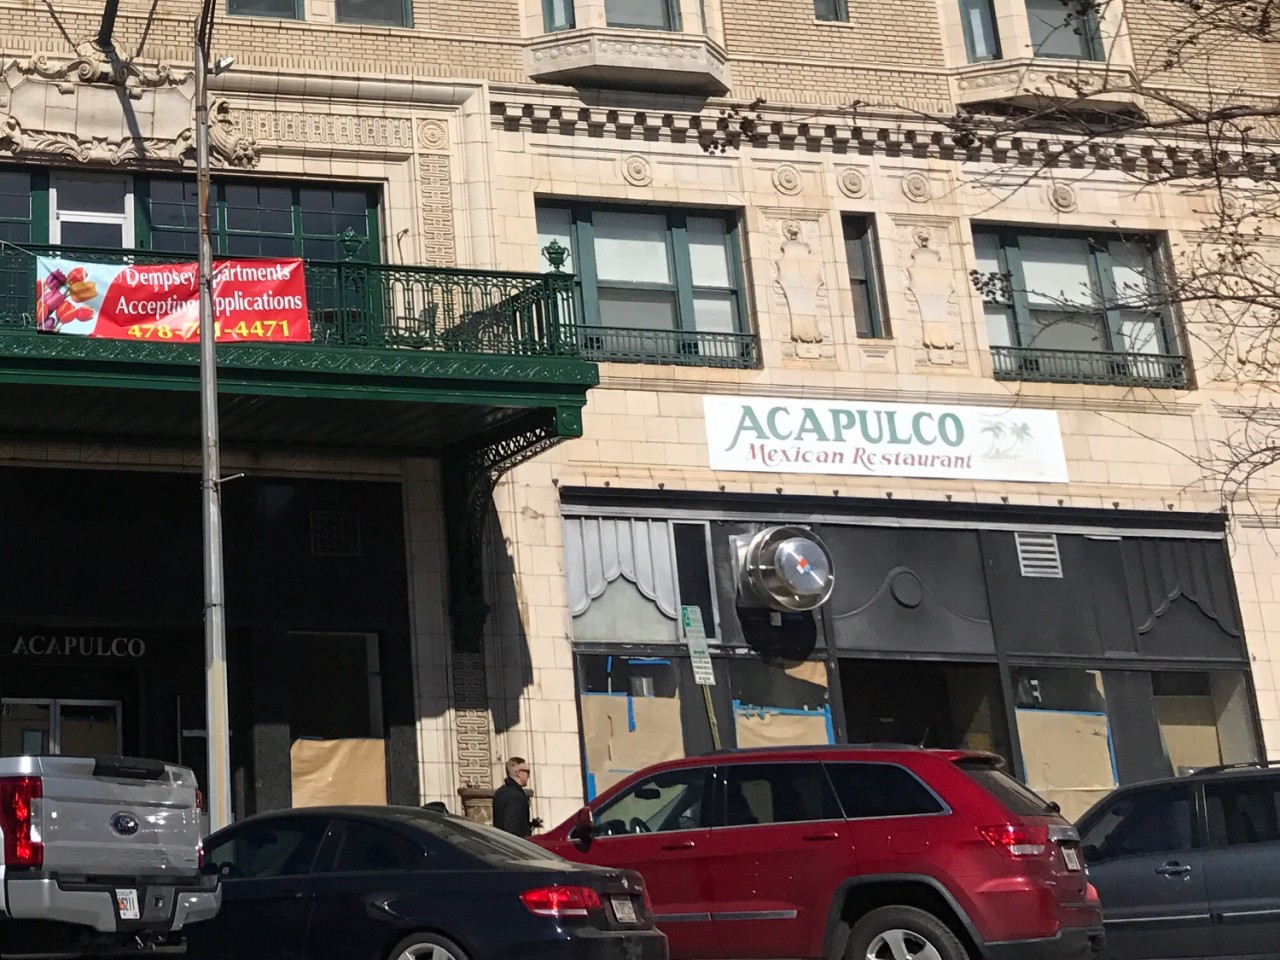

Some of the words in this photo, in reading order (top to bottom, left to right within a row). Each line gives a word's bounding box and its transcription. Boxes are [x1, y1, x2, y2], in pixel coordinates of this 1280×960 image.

[126, 266, 195, 291] Dempsey
[212, 263, 290, 284] partments
[115, 294, 198, 319] Accepting
[214, 292, 303, 317] pplications
[127, 319, 290, 340] 478-71-4471
[724, 405, 965, 452] ACAPULCO
[747, 442, 844, 468] Mexican
[852, 446, 972, 471] Restaurant
[12, 635, 146, 657] ACAPULCO
